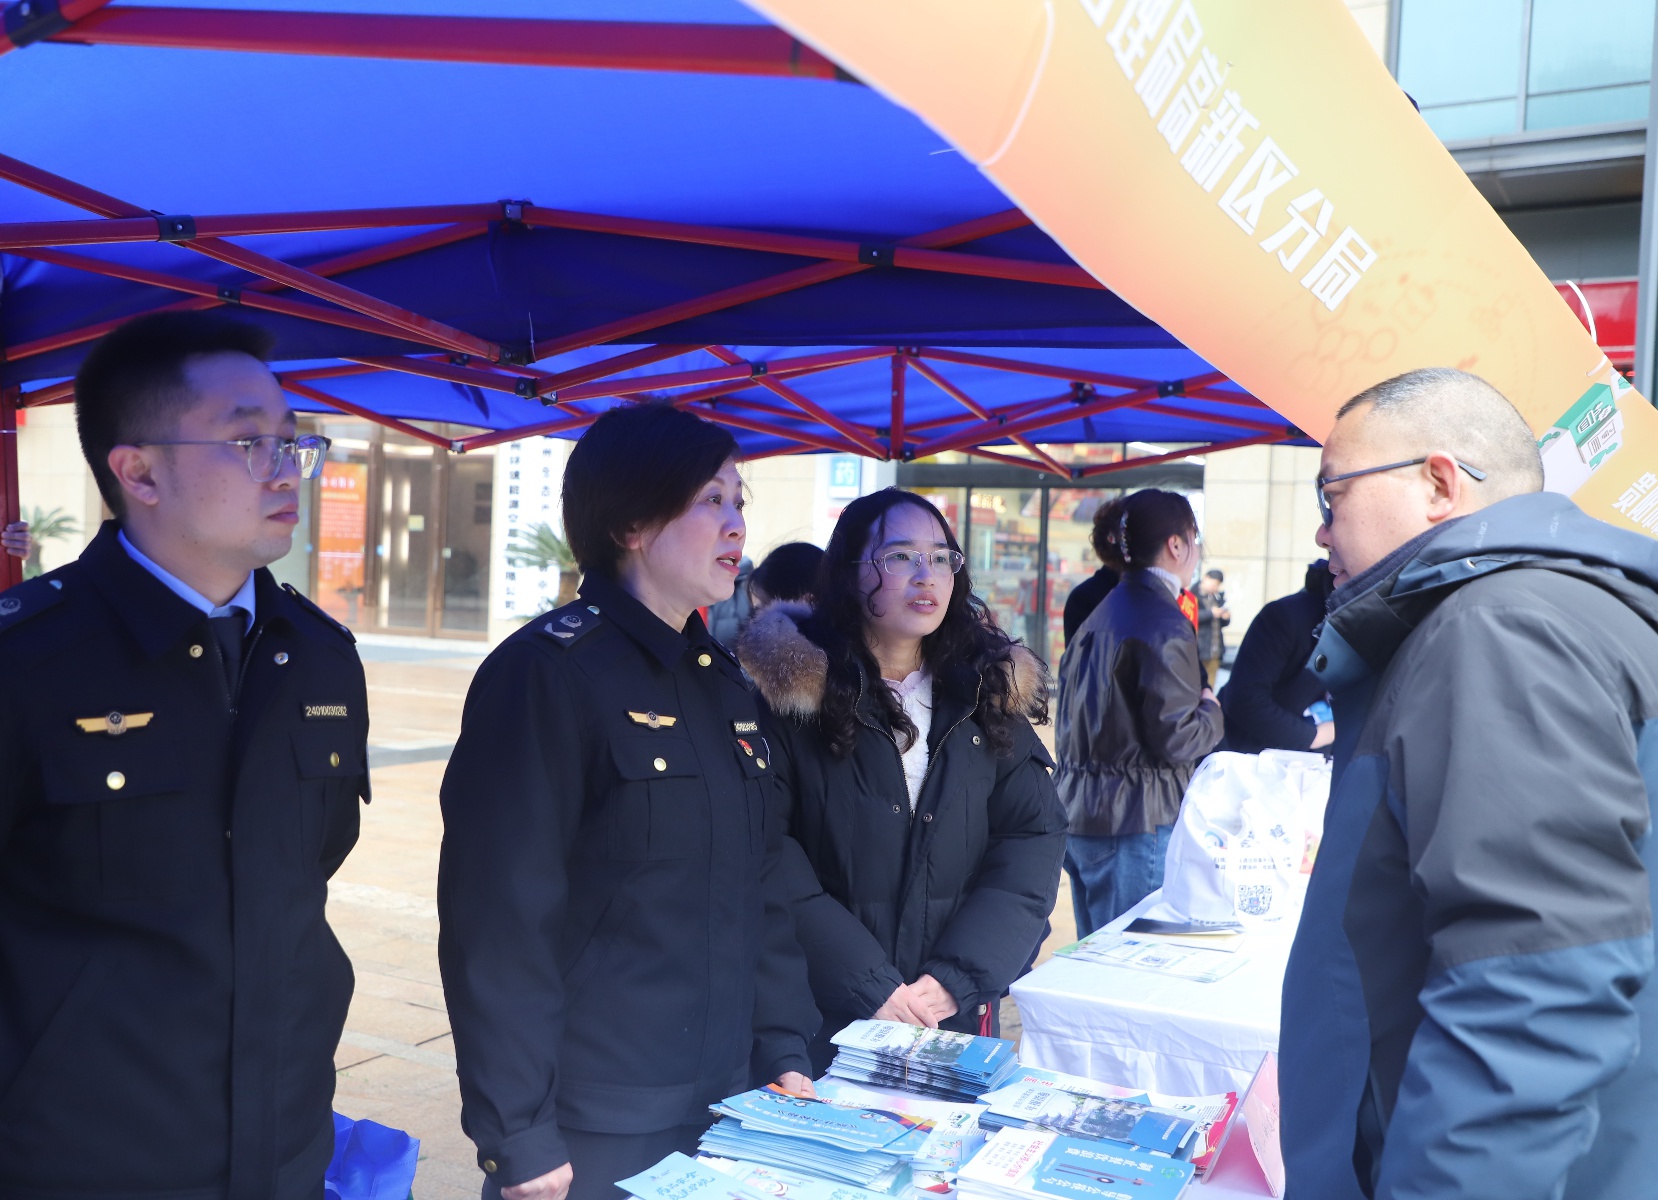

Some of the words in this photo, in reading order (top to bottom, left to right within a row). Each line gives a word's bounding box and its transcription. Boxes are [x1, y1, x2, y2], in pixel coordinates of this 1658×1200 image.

[1080, 0, 1378, 312] 理局高新区分局
